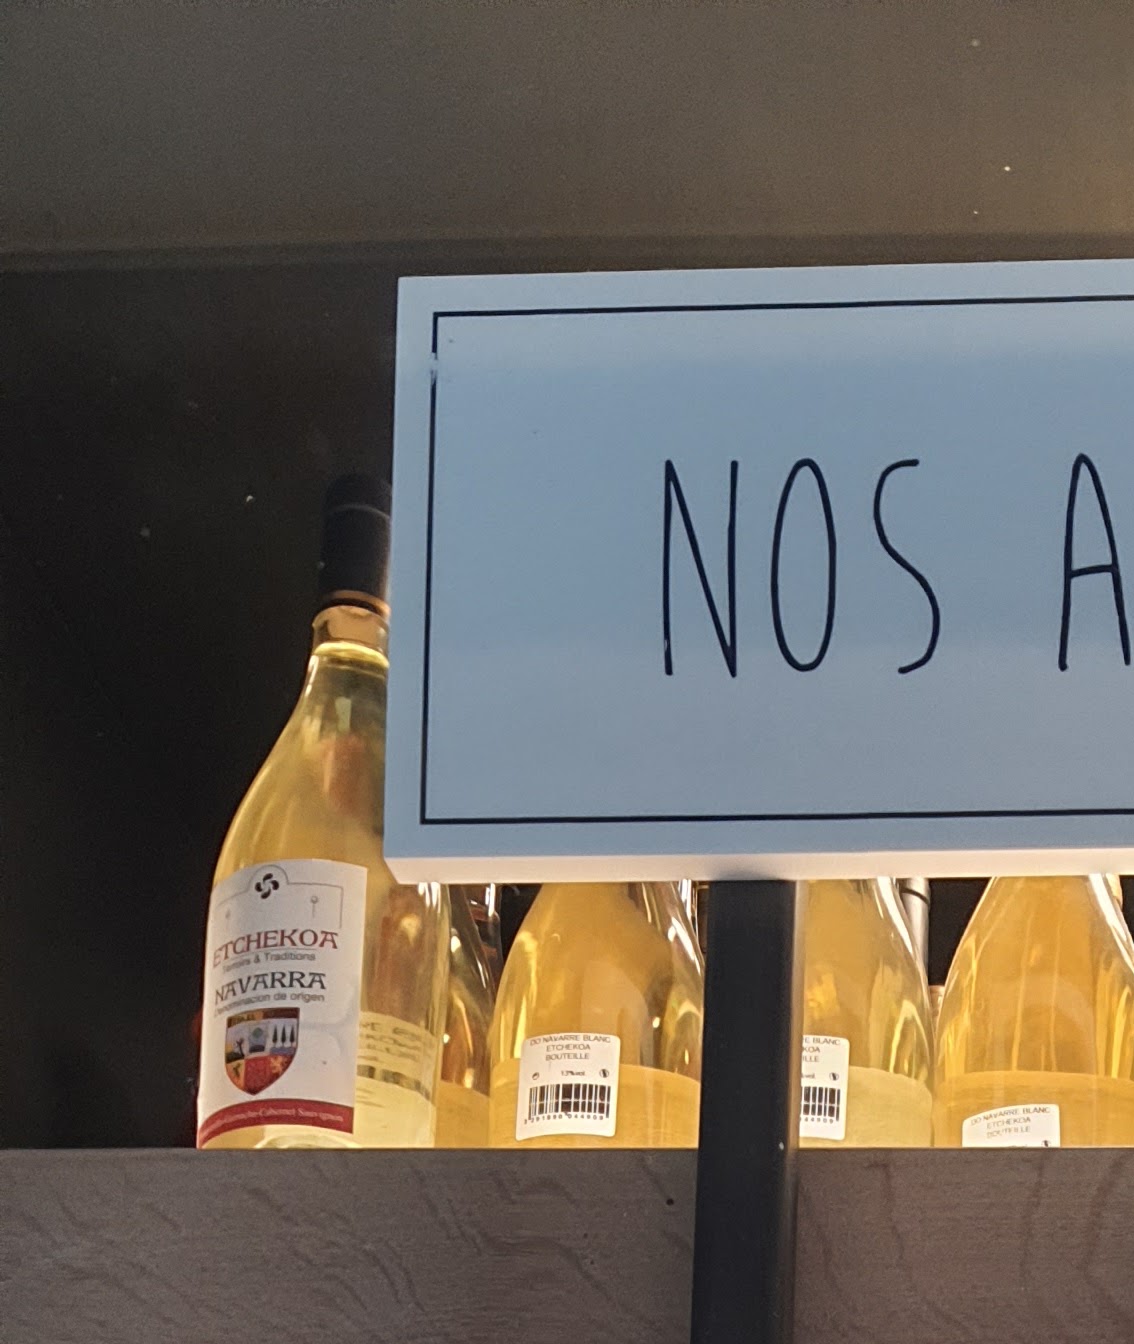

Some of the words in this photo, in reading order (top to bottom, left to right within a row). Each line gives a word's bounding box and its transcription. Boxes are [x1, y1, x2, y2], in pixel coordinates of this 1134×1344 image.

[663, 457, 944, 678] NOS
[212, 928, 339, 969] ETCHEKOA
[264, 951, 316, 963] Traditions
[215, 971, 327, 1006] NAVARRA
[289, 991, 325, 1003] origen
[582, 1034, 611, 1043] BLANC
[812, 1037, 841, 1046] BLANC
[546, 1043, 591, 1052] ETCHEKOA
[545, 1052, 590, 1062] BOUTEILLE
[1022, 1106, 1051, 1114] BLANC
